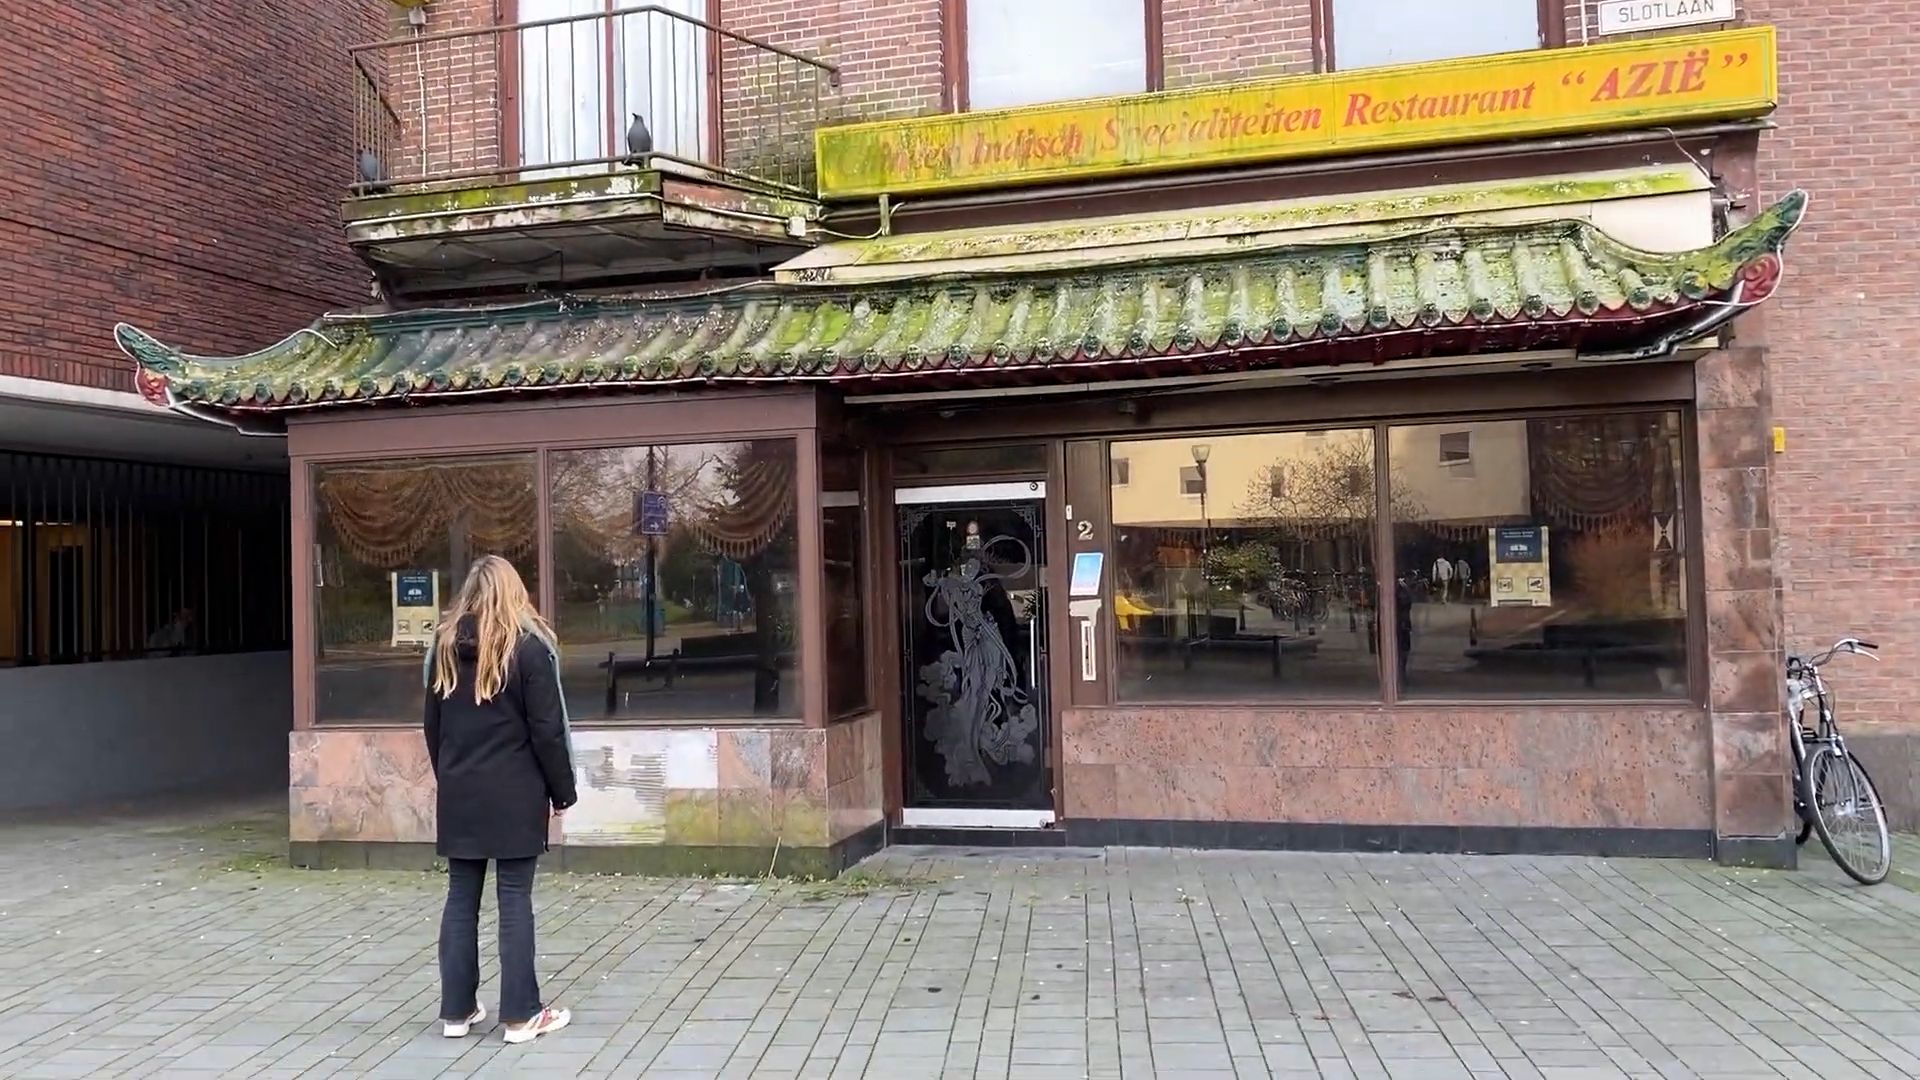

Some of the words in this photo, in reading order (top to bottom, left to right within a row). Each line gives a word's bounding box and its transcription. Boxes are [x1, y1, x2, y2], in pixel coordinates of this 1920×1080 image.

[1618, 0, 1714, 23] SLOTLAAN
[969, 122, 1083, 166] Indisch
[1343, 81, 1536, 127] Restaurant
[1077, 520, 1094, 541] 2
